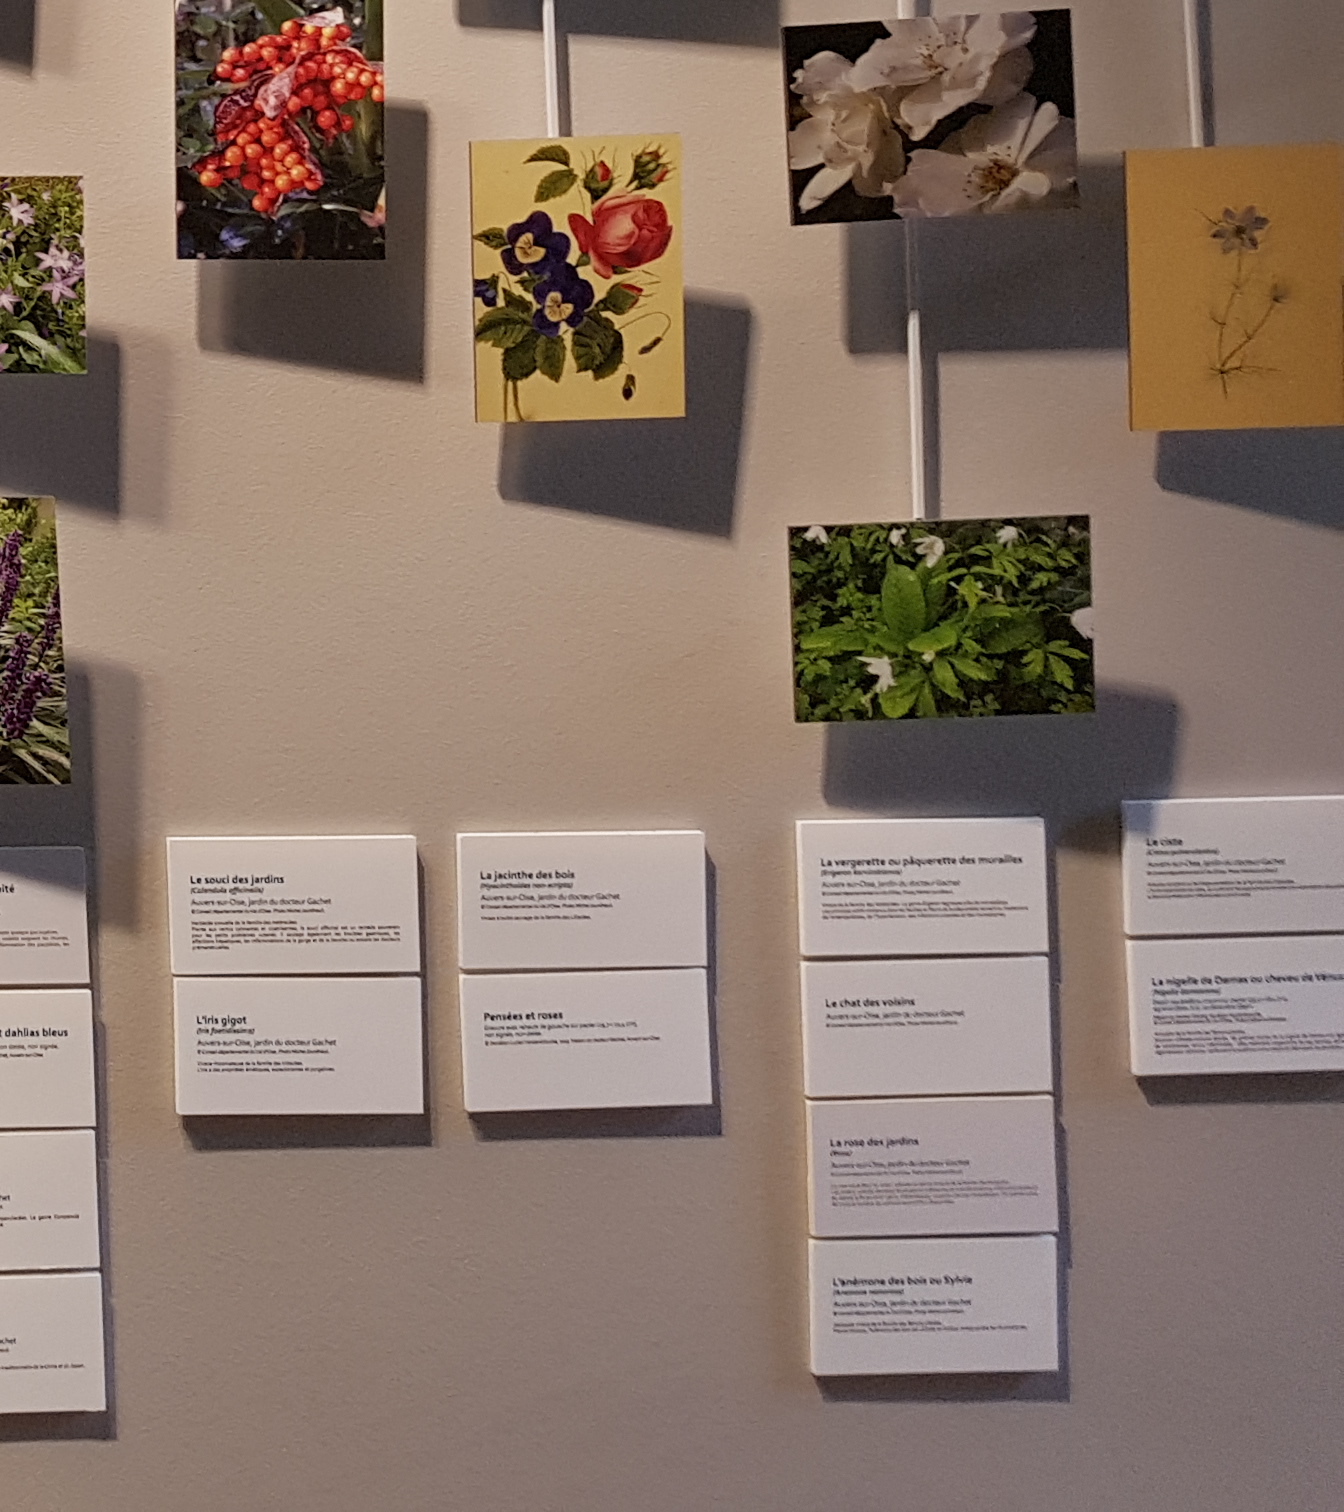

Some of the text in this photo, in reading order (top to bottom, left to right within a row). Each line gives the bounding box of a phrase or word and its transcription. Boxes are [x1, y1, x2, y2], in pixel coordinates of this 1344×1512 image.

[189, 875, 284, 886] Le souci des jardins
[479, 870, 575, 882] La jacinthe des bois
[220, 1016, 246, 1027] gigot
[483, 1011, 523, 1021] Pensées
[525, 1011, 535, 1020] et
[4, 1028, 39, 1037] dahlias
[42, 1028, 68, 1037] bleus
